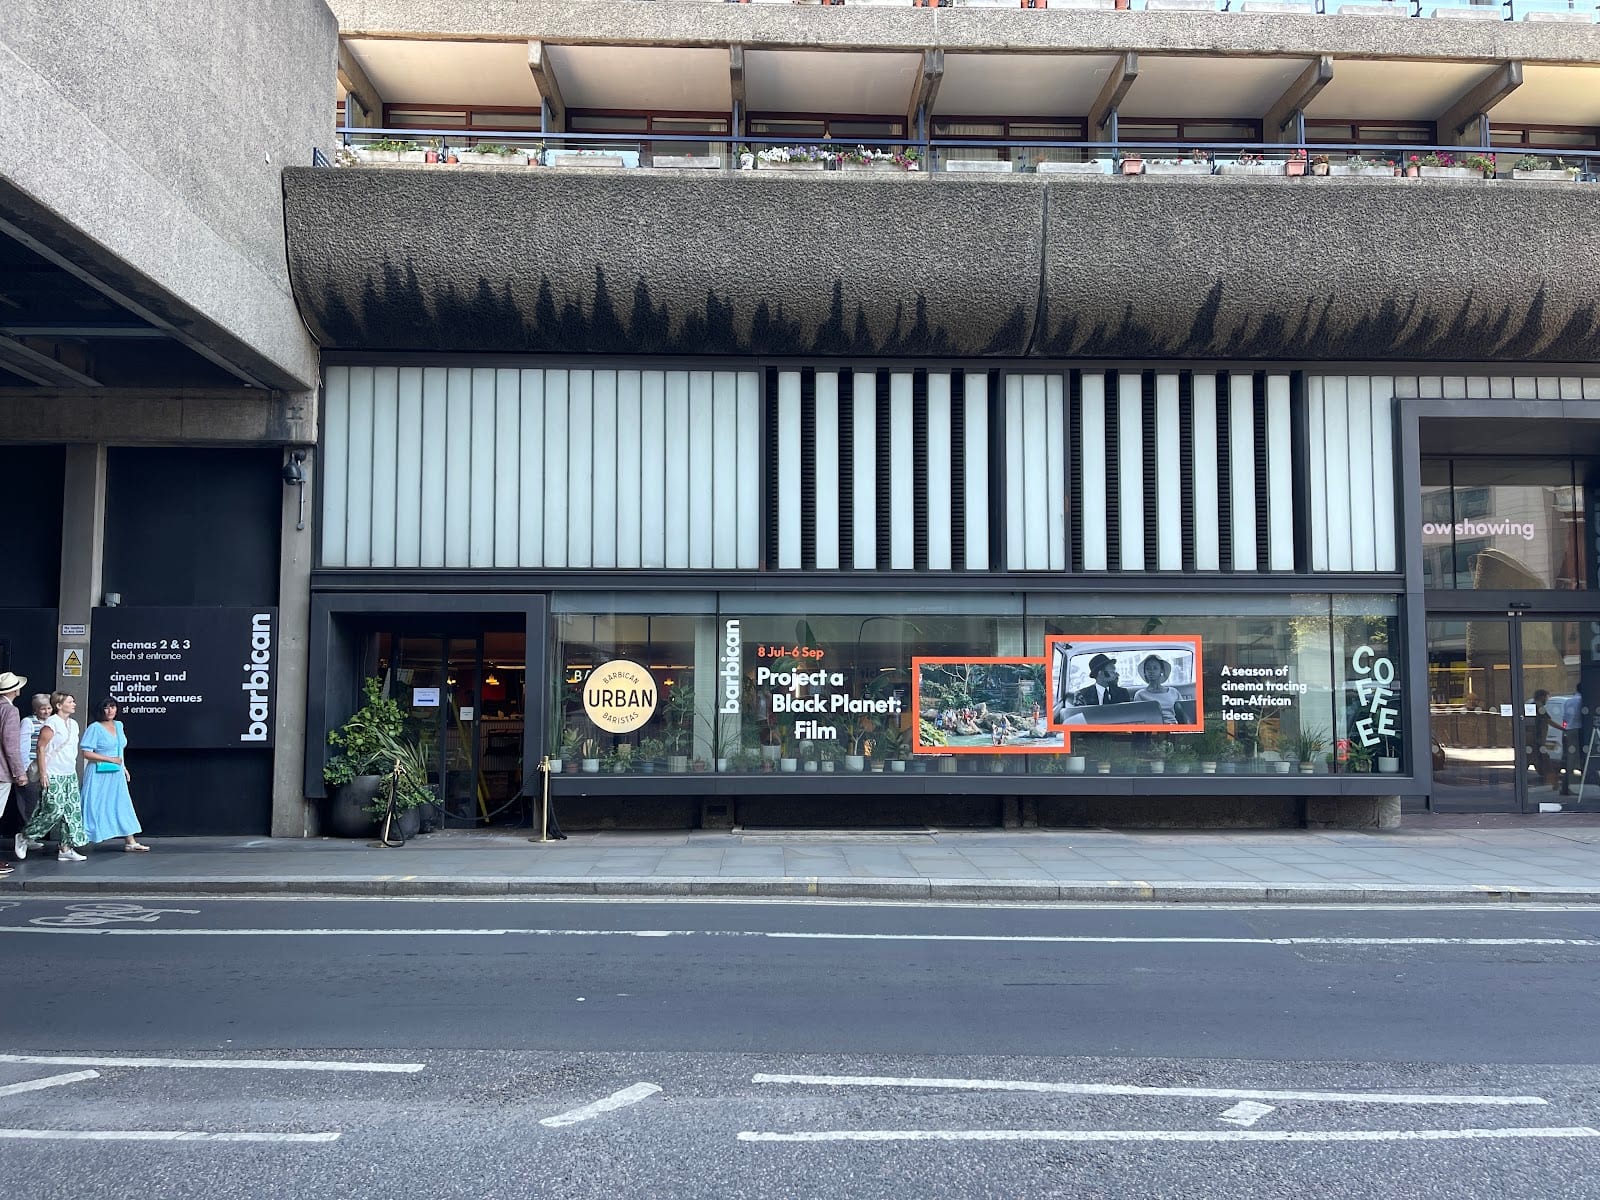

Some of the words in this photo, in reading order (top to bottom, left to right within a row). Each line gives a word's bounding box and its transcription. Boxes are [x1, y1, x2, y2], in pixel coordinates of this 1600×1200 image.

[1422, 523, 1452, 535] ow
[1454, 518, 1535, 540] showing
[111, 639, 157, 650] cinemas
[159, 640, 168, 650] 2
[170, 640, 180, 650] &
[182, 640, 191, 650] 3
[111, 651, 135, 659] beech
[757, 647, 766, 658] 8
[801, 647, 825, 660] Sep
[719, 619, 740, 714] barbican
[1221, 665, 1231, 677] A
[1232, 668, 1272, 677] season
[1275, 665, 1288, 677] of
[111, 672, 150, 681] cinema
[155, 672, 159, 681] 1
[164, 671, 186, 681] and
[241, 614, 270, 741] barbican
[602, 672, 640, 684] BARBICAN
[757, 667, 828, 687] Project
[830, 674, 843, 686] a
[109, 682, 124, 692] all
[126, 682, 158, 692] other
[1221, 681, 1263, 692] cinema
[1265, 681, 1308, 695] tracing
[161, 695, 203, 703] venues
[588, 689, 654, 708] URBAN
[1222, 695, 1291, 706] Pan-African
[1352, 645, 1398, 747] COFFEE
[772, 694, 828, 713] Black
[830, 694, 902, 713] Planet:
[602, 711, 640, 724] BARISTAS
[1222, 709, 1254, 721] ideas
[795, 721, 837, 739] Film
